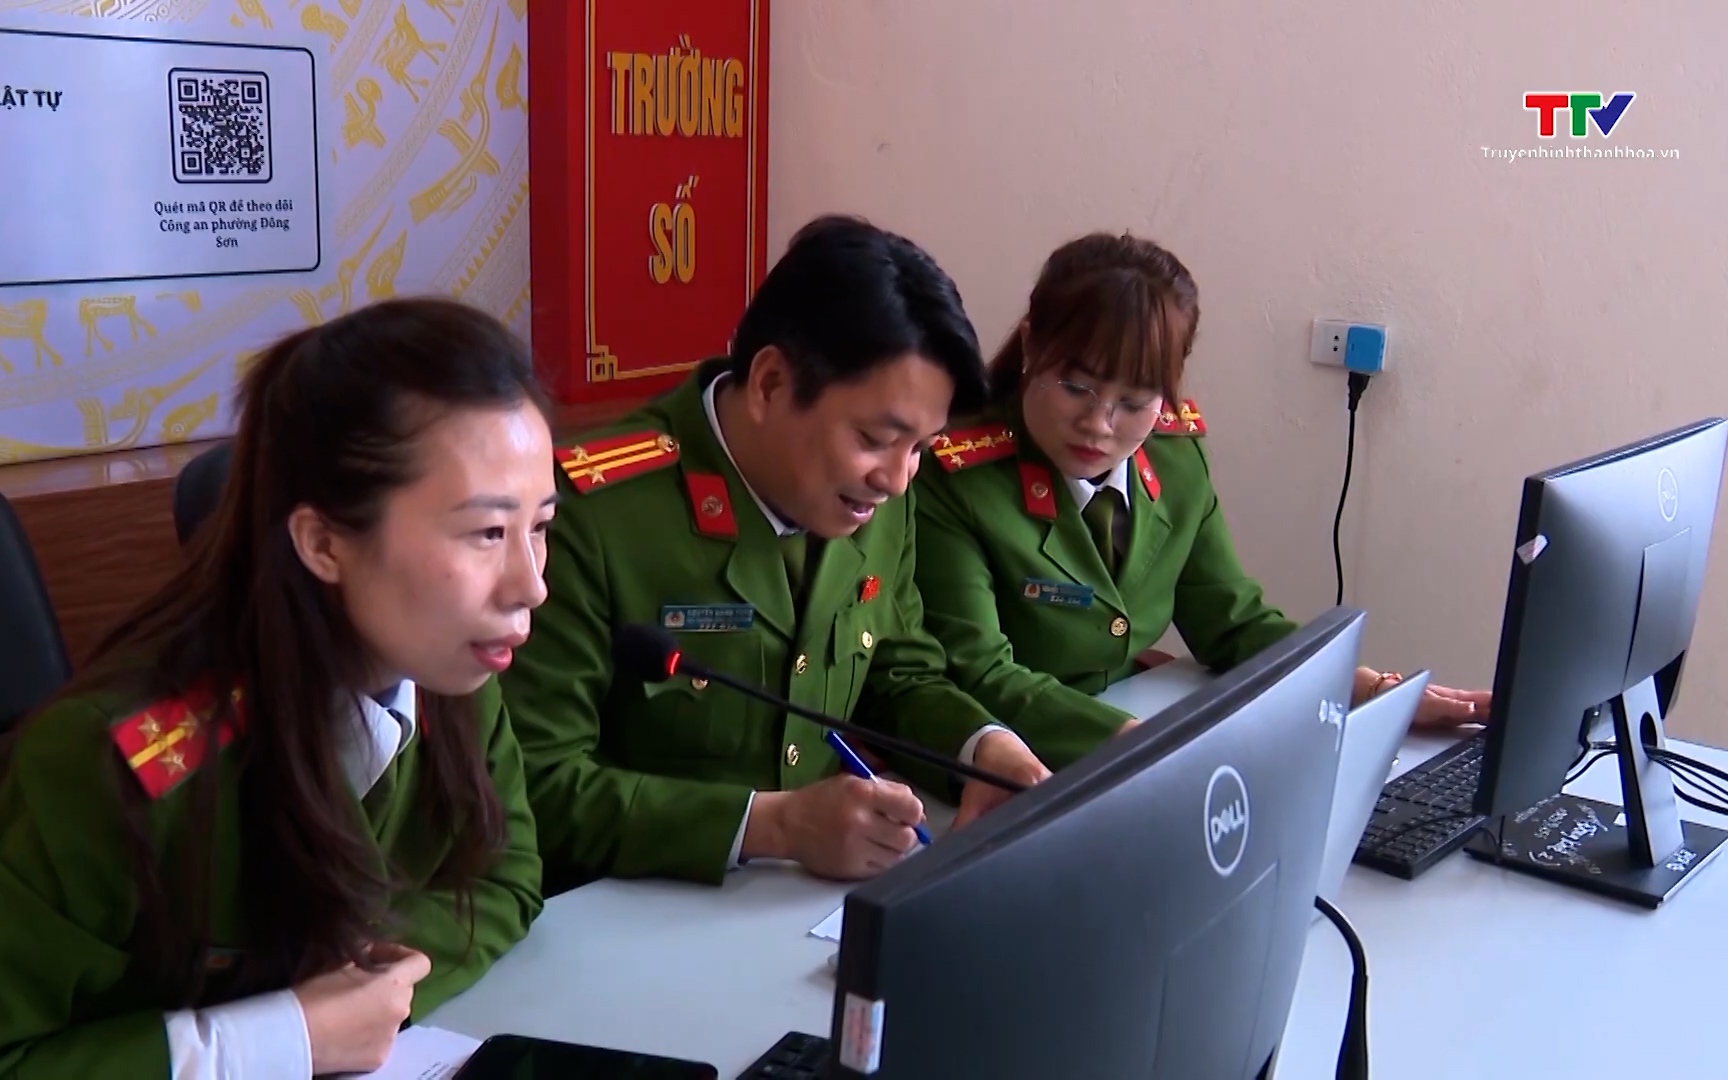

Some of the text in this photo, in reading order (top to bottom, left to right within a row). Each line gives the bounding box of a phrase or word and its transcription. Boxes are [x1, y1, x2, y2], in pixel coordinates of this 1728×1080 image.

[0, 84, 63, 112] ẬT TỰ
[607, 33, 744, 138] TRƯỜNG
[154, 201, 184, 216] Quét
[187, 201, 206, 213] mã
[209, 201, 227, 216] QR
[229, 199, 244, 212] để
[246, 199, 272, 212] theo
[159, 216, 290, 234] Công an phường Đông
[649, 174, 699, 284] SỐ
[216, 235, 239, 248] Sơn
[1211, 799, 1245, 843] DELL
